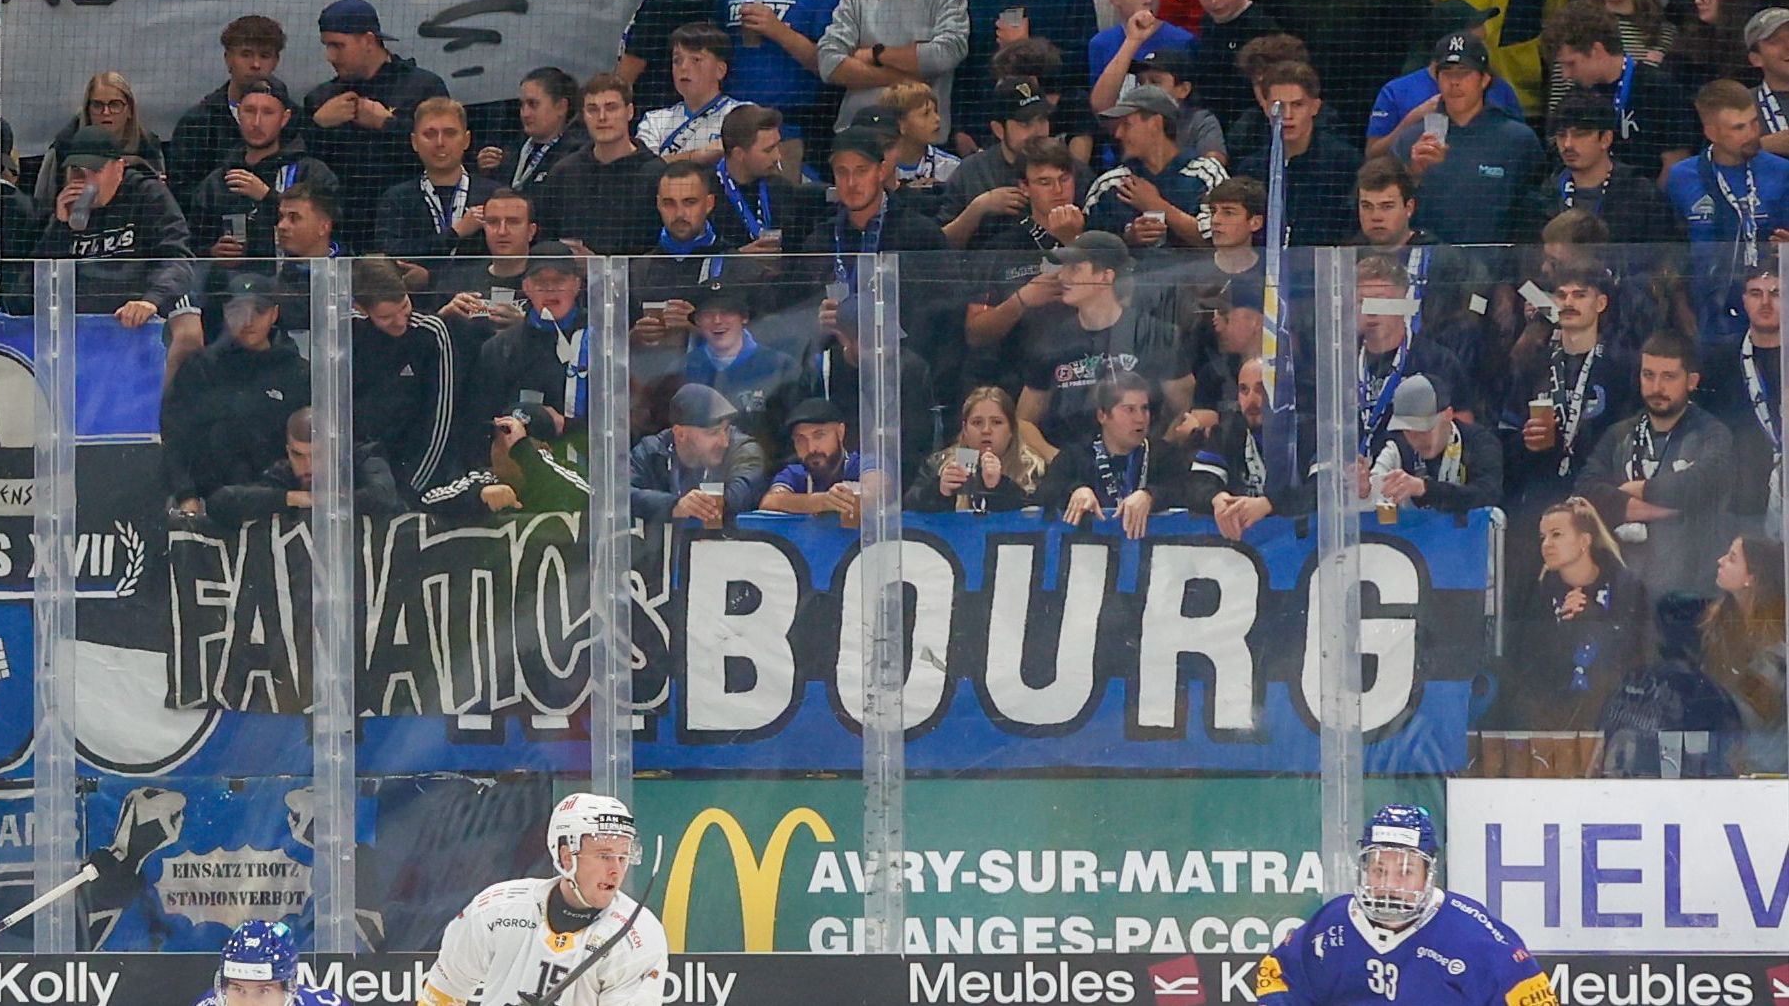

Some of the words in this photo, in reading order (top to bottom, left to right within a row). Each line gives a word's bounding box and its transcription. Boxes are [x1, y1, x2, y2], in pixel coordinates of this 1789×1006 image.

[28, 532, 114, 577] XVII
[167, 511, 673, 716] FANATICS
[685, 539, 1420, 733] BOURG
[172, 861, 242, 879] EINSATZ
[244, 861, 300, 878] TROTZ
[1484, 822, 1789, 929] HELV
[166, 889, 306, 908] STADIONVERBOT
[909, 961, 1135, 1004] Meubles
[1366, 958, 1400, 1001] 33
[1549, 963, 1754, 1006] Meubles
